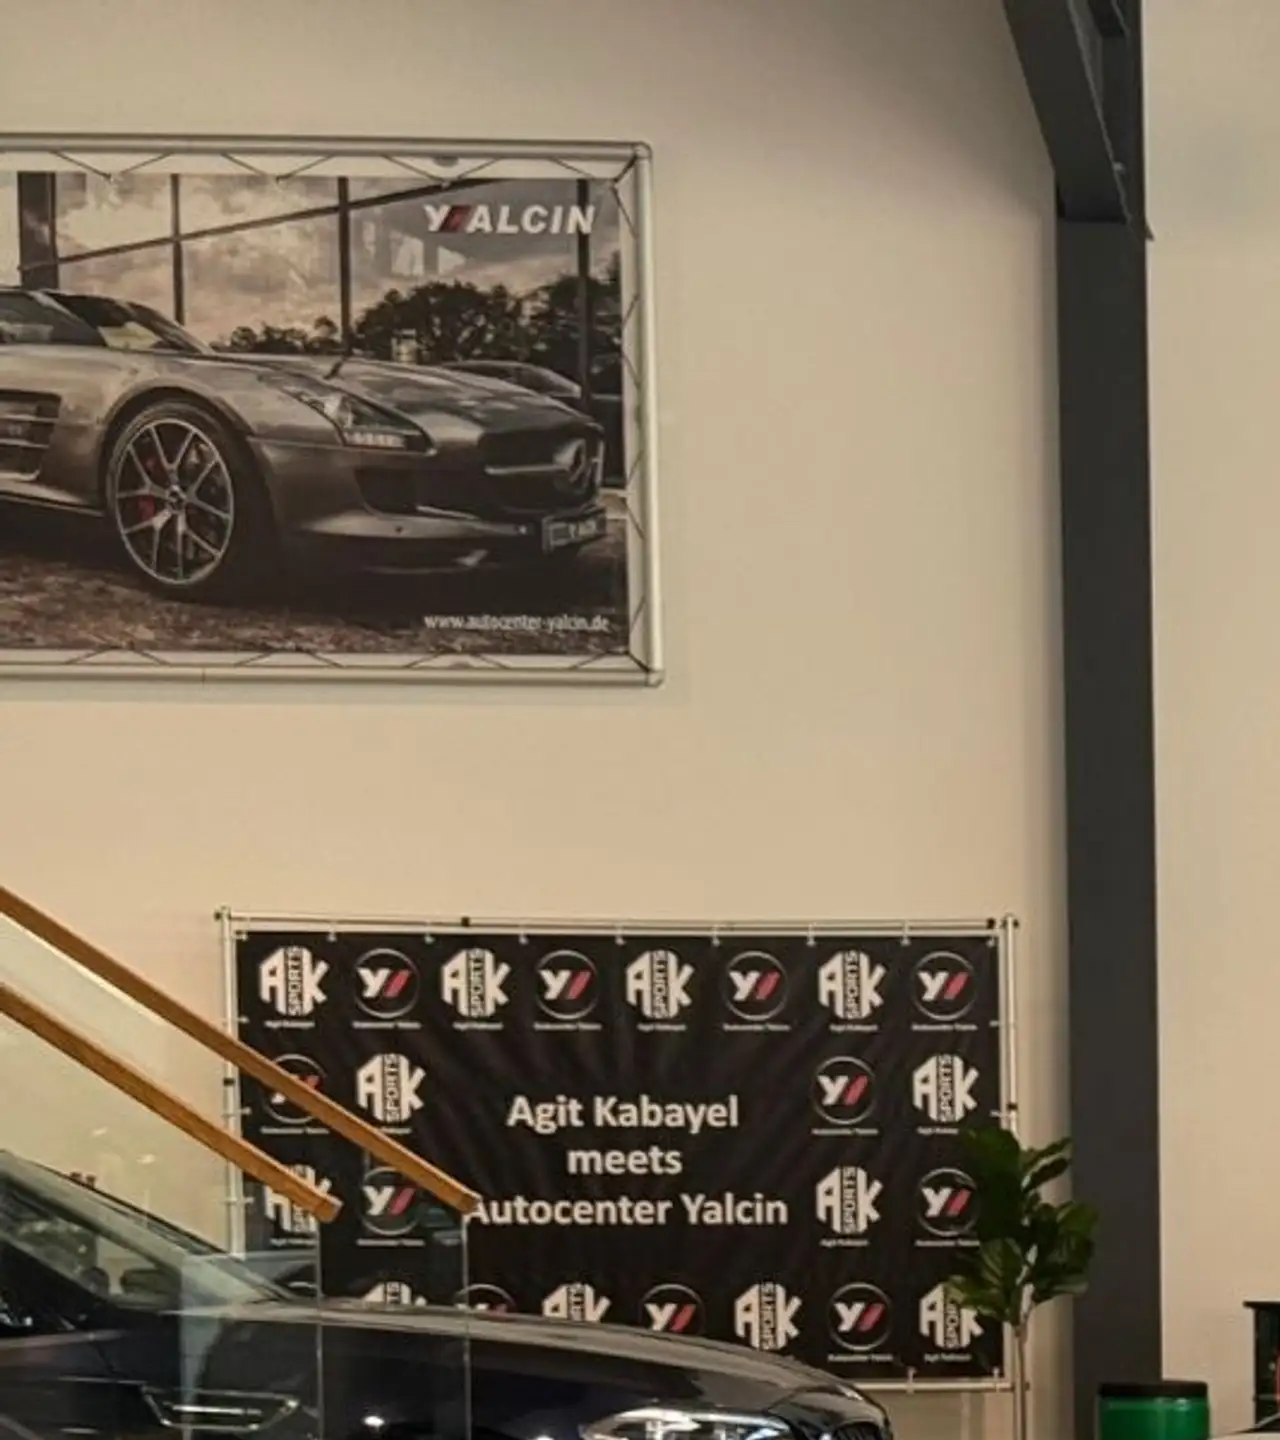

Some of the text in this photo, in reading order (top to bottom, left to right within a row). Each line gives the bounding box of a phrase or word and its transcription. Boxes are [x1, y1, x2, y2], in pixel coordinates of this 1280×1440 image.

[423, 204, 596, 235] YALCIN
[423, 614, 610, 634] www.autocenter-yalcin.de
[507, 1095, 739, 1135] Agit Kabayel
[567, 1146, 684, 1176] meets
[681, 1193, 789, 1226] Yalcin
